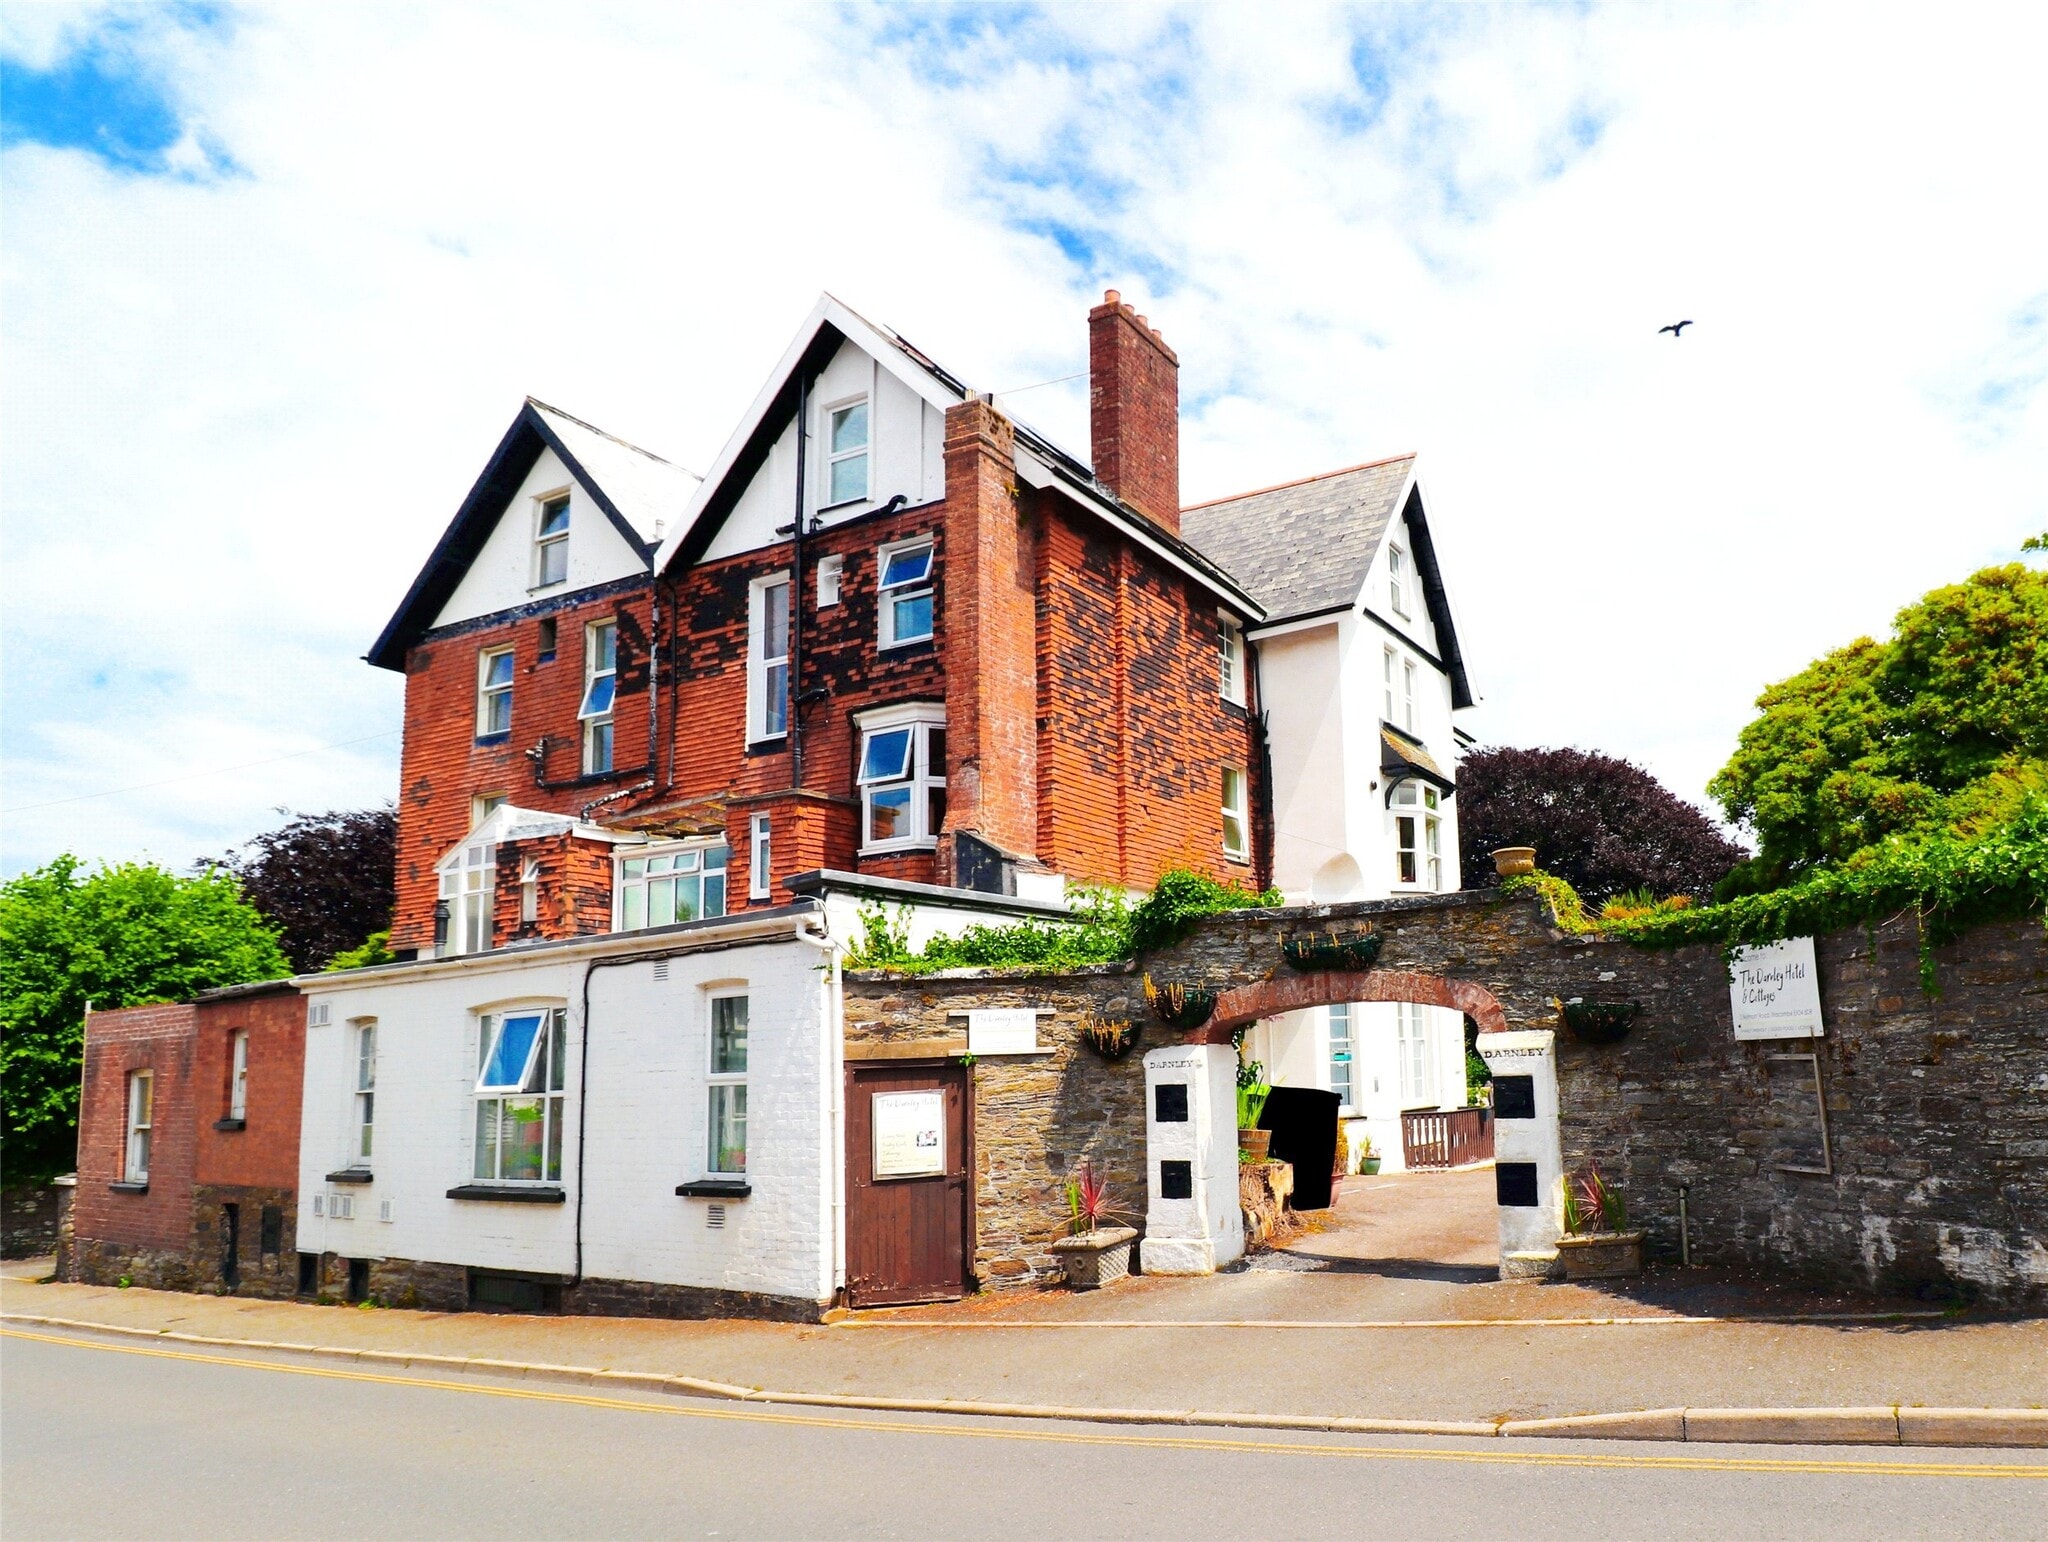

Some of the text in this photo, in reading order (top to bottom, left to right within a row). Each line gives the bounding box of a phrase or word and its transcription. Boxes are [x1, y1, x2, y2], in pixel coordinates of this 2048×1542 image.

[1739, 962, 1805, 991] The Darnley Hotel
[1742, 988, 1776, 1007] & Cottages
[1484, 1048, 1544, 1059] DARNLEY
[1150, 1060, 1194, 1069] DARNLEY
